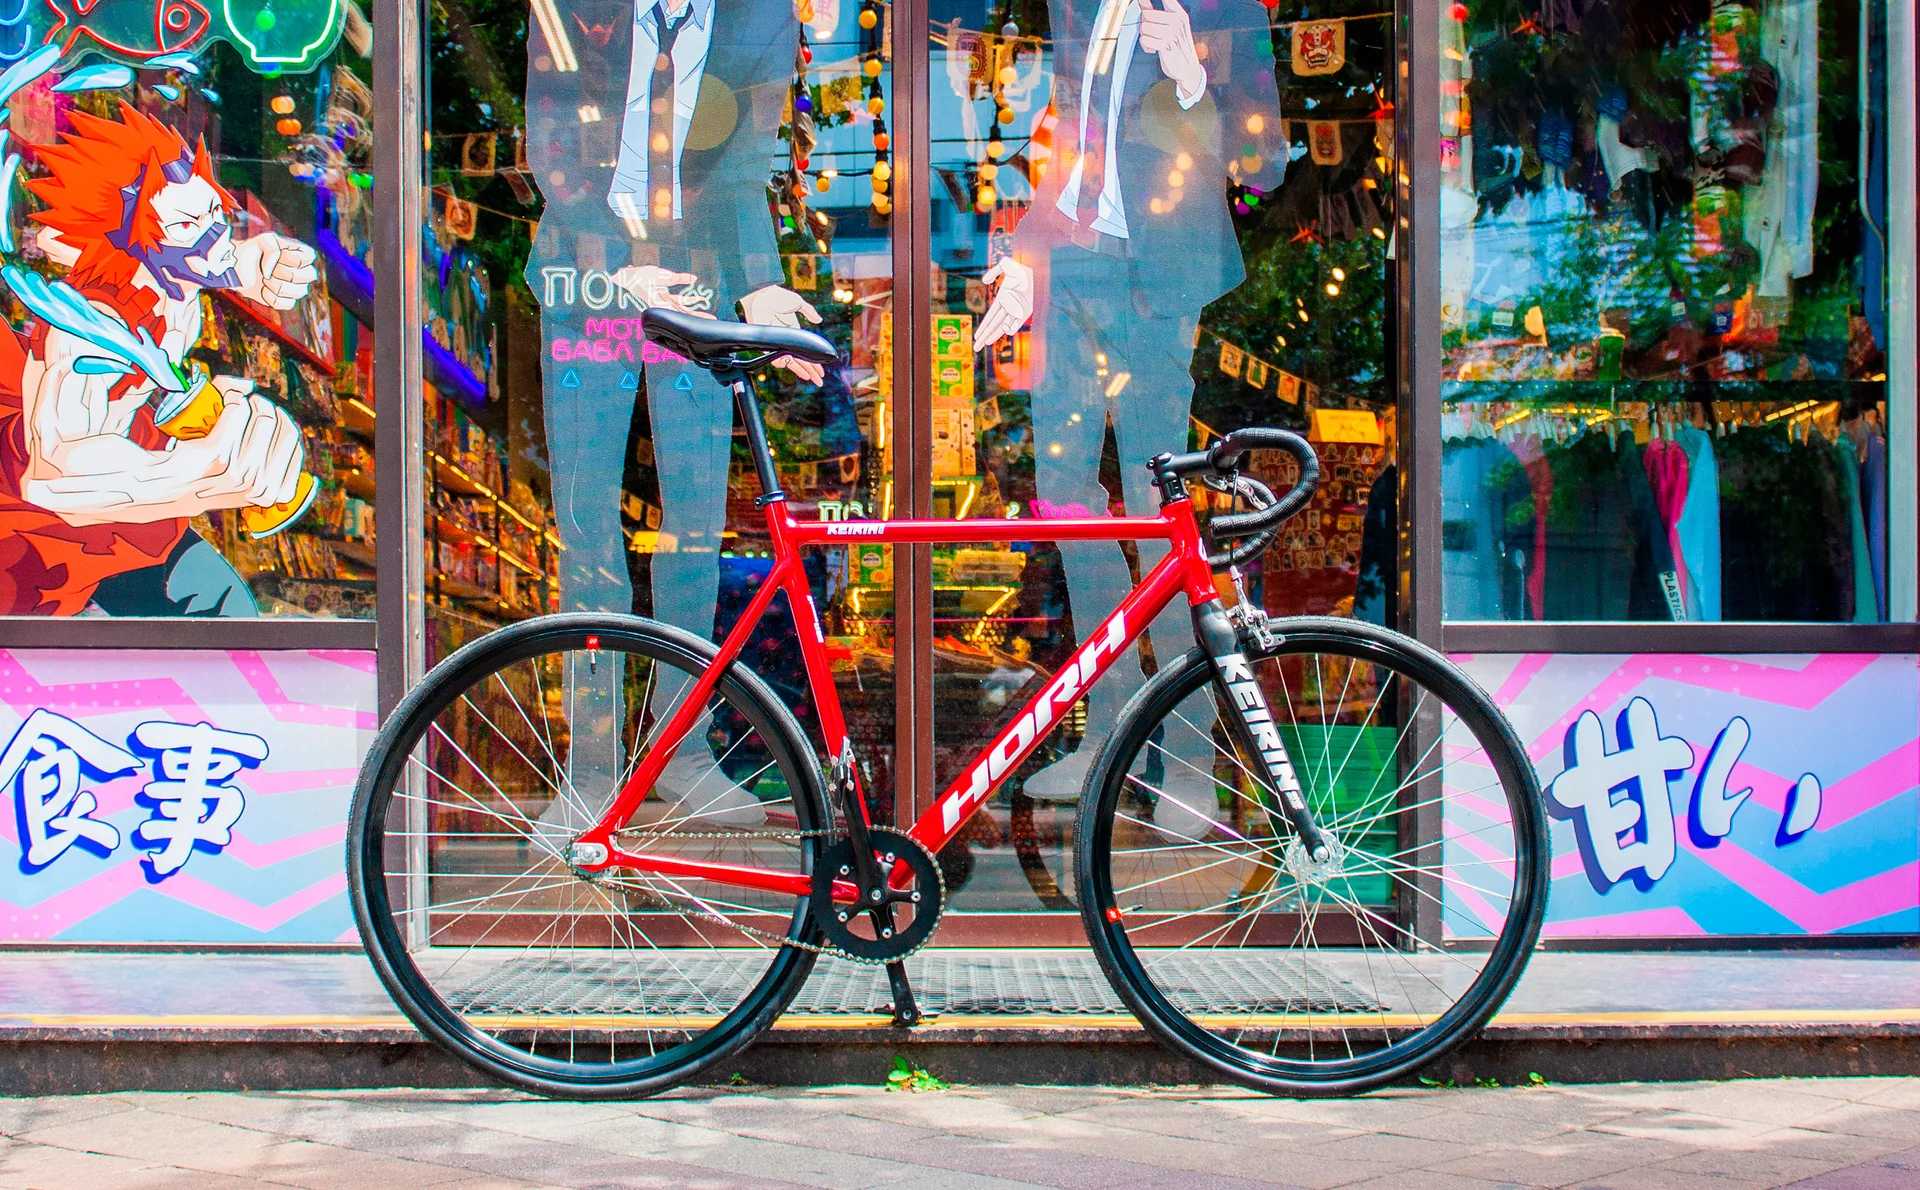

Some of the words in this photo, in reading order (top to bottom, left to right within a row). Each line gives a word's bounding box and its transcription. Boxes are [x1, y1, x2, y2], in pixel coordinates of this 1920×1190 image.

[585, 317, 643, 341] МОТ
[0, 707, 270, 884] 食事
[942, 610, 1126, 835] HORH
[1214, 653, 1300, 792] KEIRIN
[1543, 696, 1822, 895] 甘い
